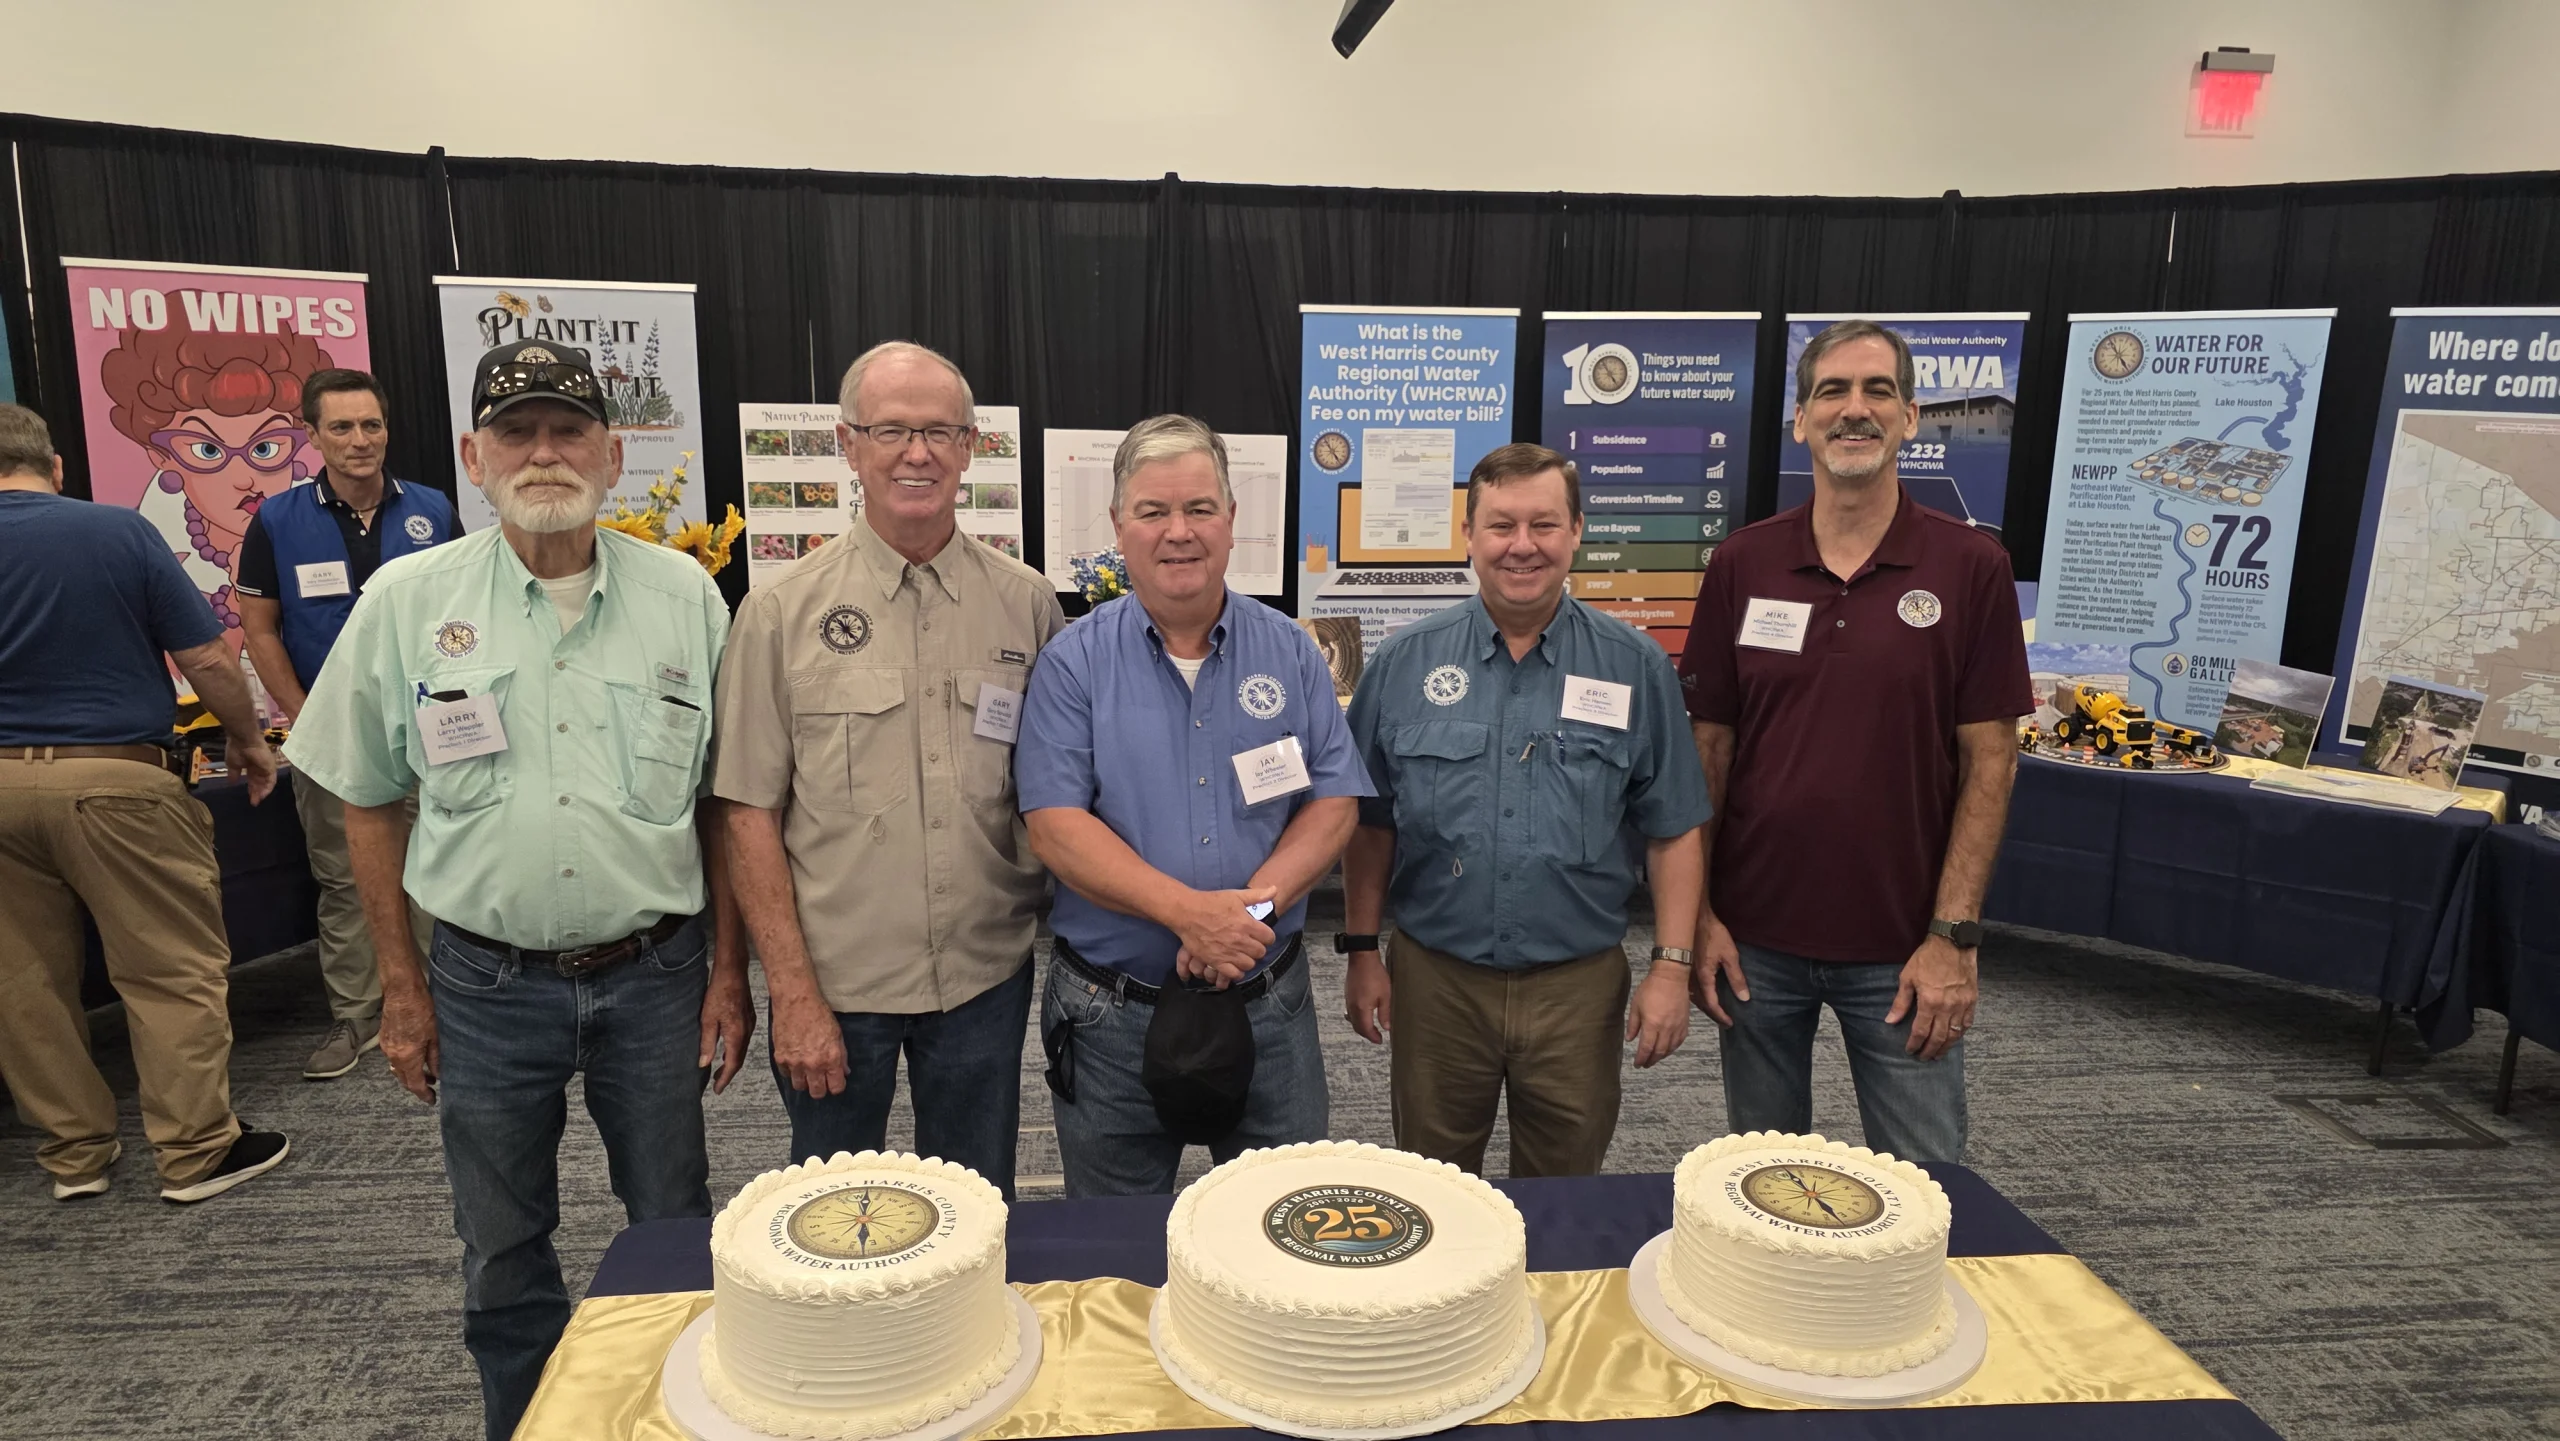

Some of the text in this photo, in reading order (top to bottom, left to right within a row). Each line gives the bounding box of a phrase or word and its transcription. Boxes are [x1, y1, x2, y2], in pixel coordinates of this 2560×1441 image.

[88, 286, 356, 338] NO WIPES
[477, 307, 640, 348] PLANT IT
[1358, 324, 1462, 341] What is the
[1931, 337, 1961, 345] Water
[1962, 336, 2007, 347] Authority
[2155, 335, 2263, 352] WATER FOR
[2429, 331, 2519, 361] Where
[1319, 344, 1499, 366] West Harris County
[1642, 353, 1720, 368] Things you need
[1912, 355, 2004, 388] RWA
[2151, 356, 2270, 375] OUR FUTURE
[1337, 364, 1480, 385] Regional Water
[1562, 343, 1639, 404] 10
[1642, 371, 1734, 385] to know about your
[2404, 368, 2487, 396] water
[1308, 383, 1507, 405] Authority (WHCRWA)
[1641, 387, 1735, 402] future water supply
[2082, 388, 2092, 396] For
[2103, 390, 2121, 398] years,
[2174, 390, 2196, 398] County
[2081, 399, 2107, 407] Regional
[2129, 399, 2158, 408] Authority
[2215, 398, 2273, 407] Lake Houston
[762, 411, 835, 423] NATIVE PLANTS
[1311, 406, 1504, 425] Fee on my water bill?
[2148, 409, 2192, 417] infrastructure
[2127, 419, 2166, 427] groundwater
[630, 434, 674, 444] APPROVED
[2078, 428, 2118, 436] requirements
[1569, 431, 1647, 450] 1 Subsidence
[2077, 436, 2106, 445] long-term
[1910, 443, 1946, 459] 232
[2113, 447, 2133, 455] region.
[1591, 465, 1643, 476] Population
[1901, 461, 1944, 470] WHCRWA
[2072, 464, 2117, 480] NEWPP
[2070, 483, 2132, 492] Northeast Water
[1590, 495, 1684, 504] Conversion Timeline
[2070, 492, 2136, 501] Purification Plant
[2097, 502, 2131, 510] Houston.
[1588, 524, 1641, 534] Luce Bayou
[2208, 514, 2272, 570] 72
[1587, 553, 1621, 561] NEWPP
[1586, 581, 1613, 589] SWSP
[2205, 570, 2270, 590] HOURS
[829, 604, 853, 613] HARRIS
[855, 606, 873, 625] COUNTY
[1312, 607, 1327, 615] The
[1376, 607, 1390, 615] fee
[1392, 607, 1410, 615] that
[1640, 610, 1674, 620] System
[1766, 611, 1788, 619] MIKE
[2191, 655, 2236, 670] 80 MILL
[1269, 676, 1286, 694] COUNTY
[1586, 689, 1608, 698] ERIC
[992, 699, 1010, 709] GARY
[440, 711, 476, 726] LARRY
[1260, 756, 1275, 767] JAY
[1728, 1158, 1903, 1209] WEST HARRIS COUNTY
[799, 1180, 957, 1238] WEST HARRIS COUNTY
[1271, 1188, 1413, 1226] WEST HARRIS COUNTY
[1724, 1181, 1902, 1239] REGIONAL WATER AUTHORITY
[1304, 1204, 1393, 1241] 25
[769, 1204, 937, 1271] REGIONAL WATER AUTHORITY
[1281, 1224, 1424, 1264] REGIONAL WATER AUTHORITY
